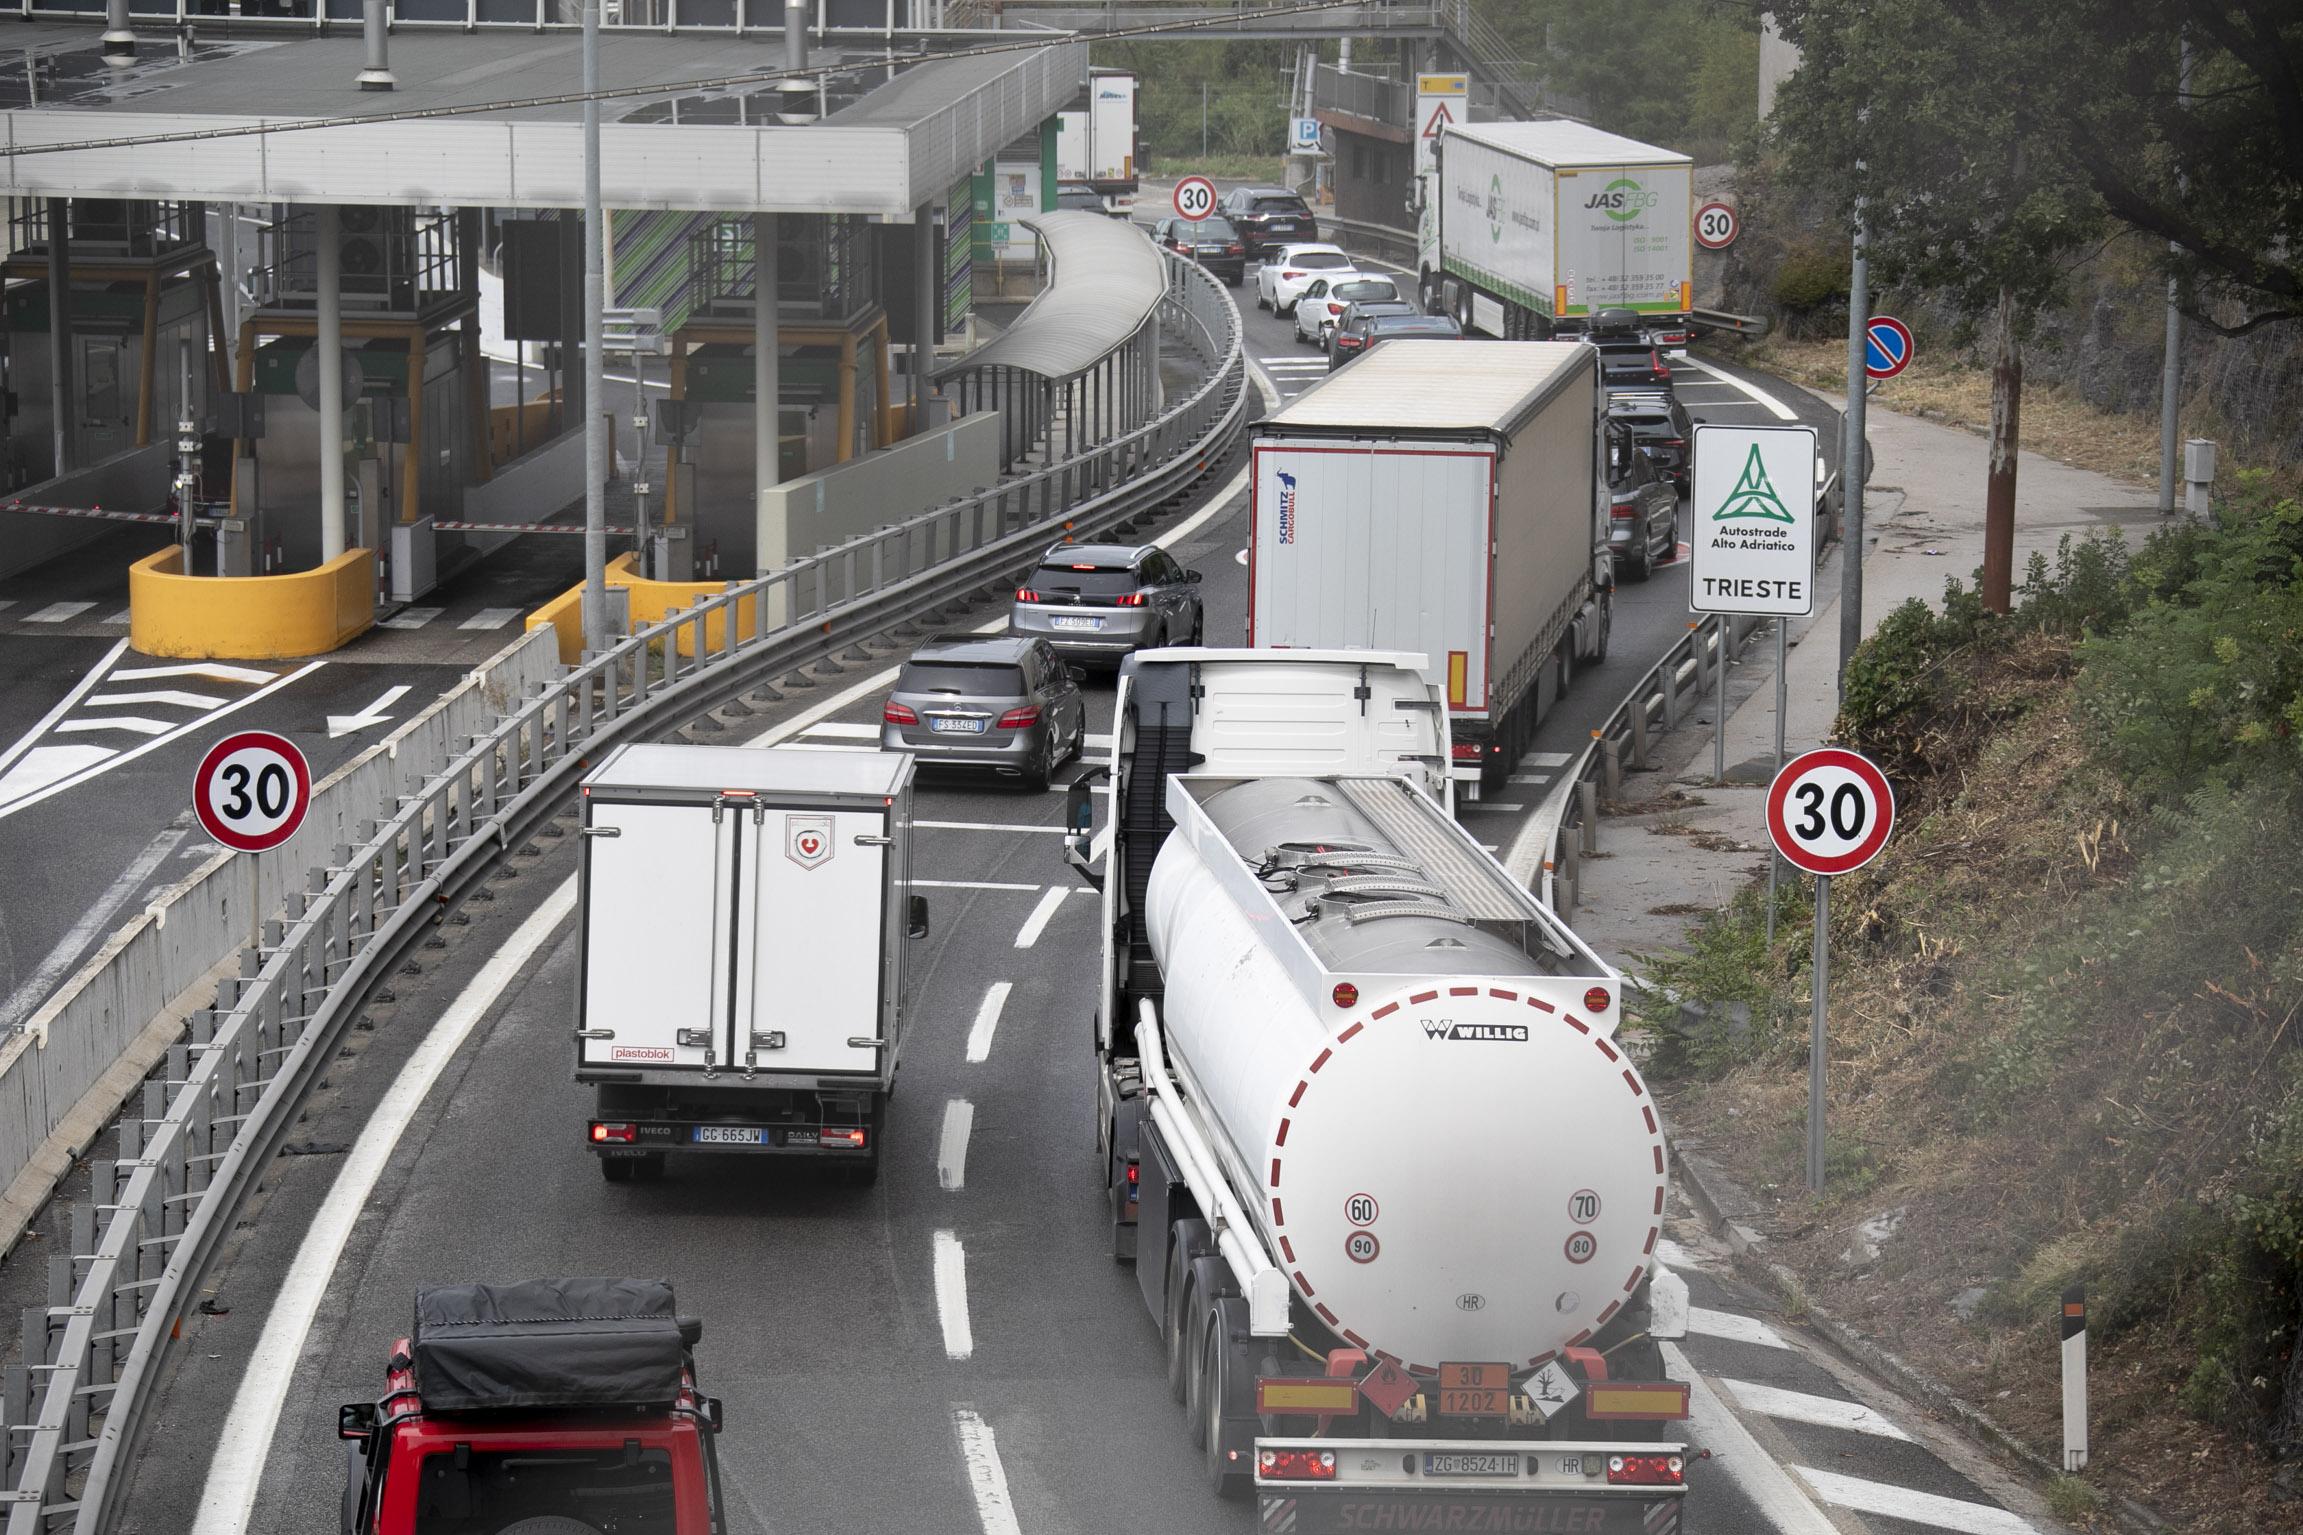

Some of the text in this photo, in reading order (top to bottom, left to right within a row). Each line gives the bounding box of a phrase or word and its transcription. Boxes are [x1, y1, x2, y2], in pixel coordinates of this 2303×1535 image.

[1184, 189, 1208, 209] 30
[1704, 214, 1730, 235] 30
[1279, 491, 1288, 545] SCHMITZ
[1288, 491, 1296, 545] CARGOBULL
[1719, 526, 1788, 538] Autostrade
[1711, 538, 1795, 551] Alto Adriatico
[1702, 577, 1802, 600] TRIESTE
[221, 762, 290, 820] 30
[1794, 782, 1866, 841] 30
[1456, 1026, 1526, 1040] WILLIG
[616, 1048, 670, 1060] plastoblok
[640, 1127, 671, 1135] IVECO
[1351, 1199, 1372, 1221] 60
[1575, 1195, 1596, 1218] 70
[1354, 1240, 1371, 1254] 90
[1573, 1240, 1589, 1253] 80
[1463, 1296, 1479, 1309] HR
[1460, 1366, 1482, 1386] 30
[1447, 1391, 1496, 1412] 1202
[1563, 1458, 1579, 1473] HR
